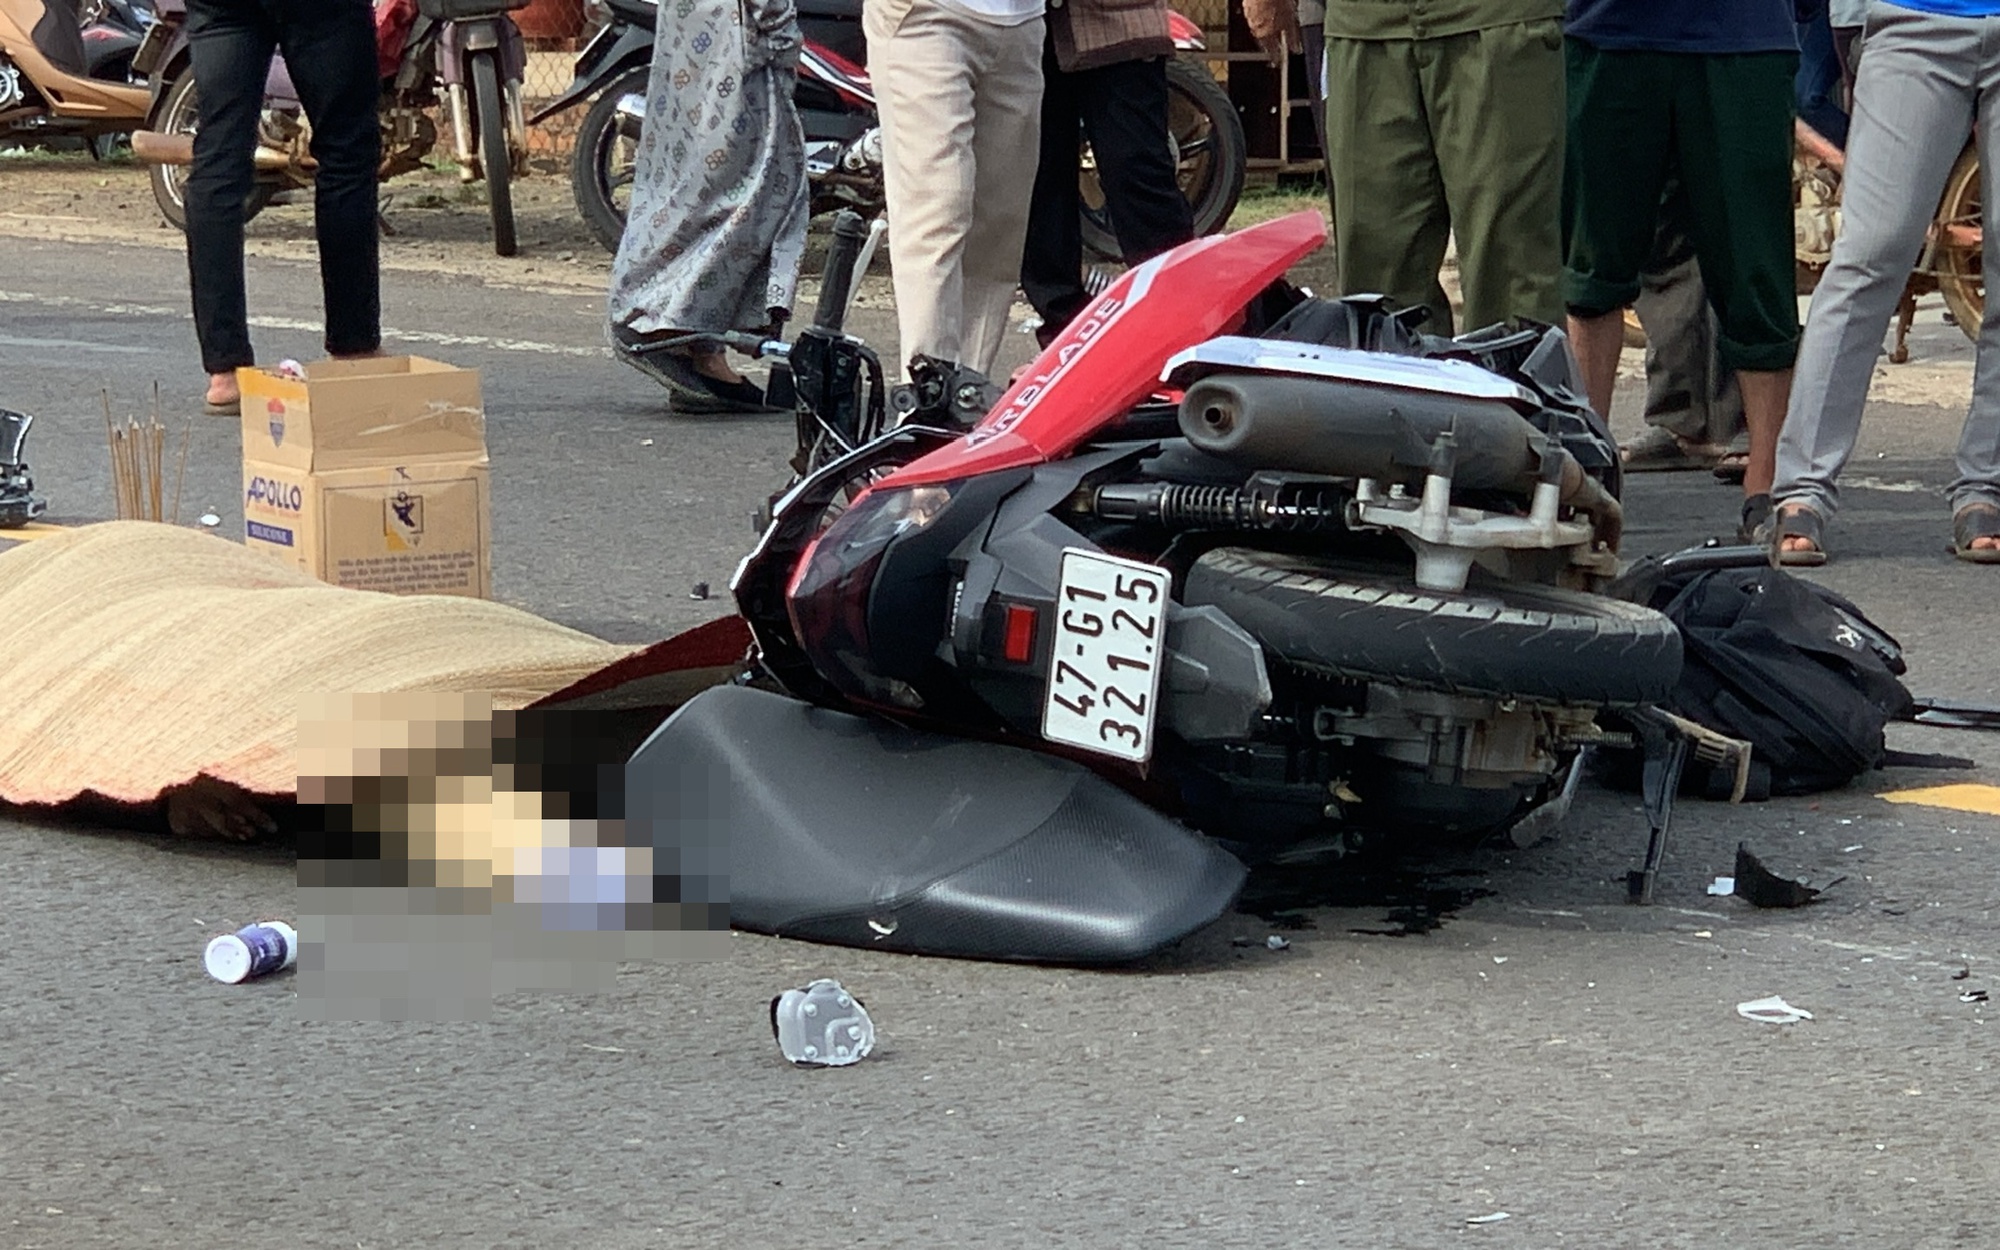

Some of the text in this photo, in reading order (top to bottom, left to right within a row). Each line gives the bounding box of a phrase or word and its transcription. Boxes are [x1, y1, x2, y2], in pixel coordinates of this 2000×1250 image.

[246, 476, 302, 511] APOLLO
[1053, 585, 1107, 717] 47-G1
[1099, 574, 1158, 748] 321.25
